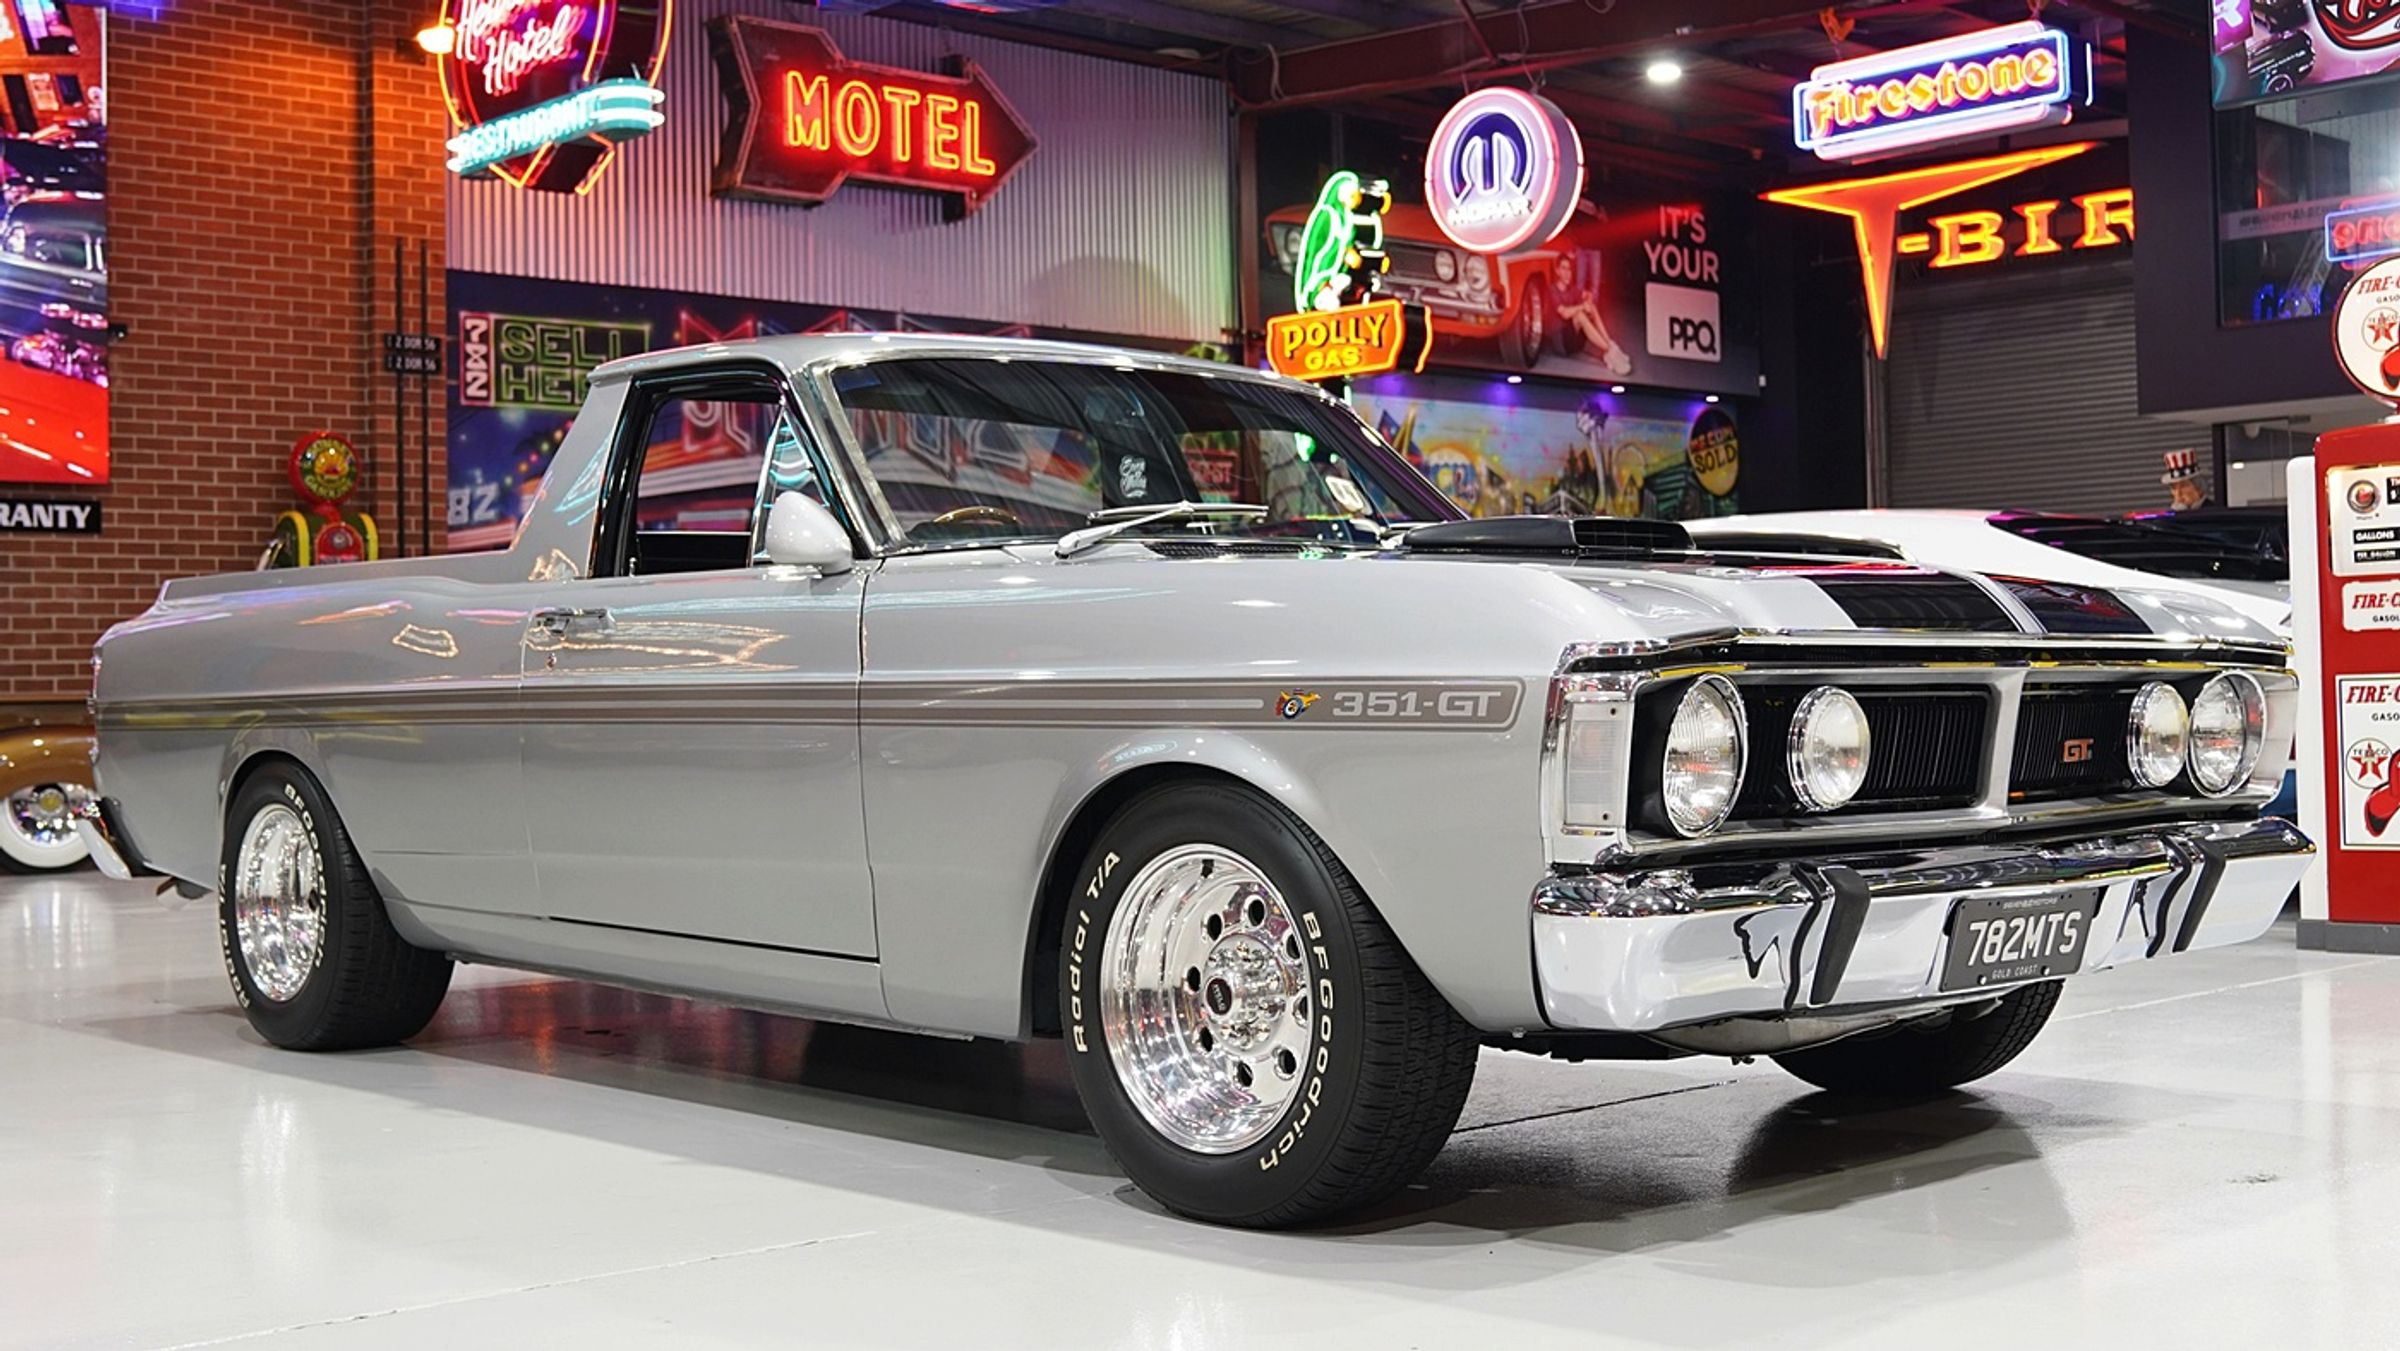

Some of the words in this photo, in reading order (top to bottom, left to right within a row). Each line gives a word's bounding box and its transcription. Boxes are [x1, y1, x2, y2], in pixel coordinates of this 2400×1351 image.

[483, 4, 566, 94] Hotel
[1807, 48, 2058, 138] Firestone
[458, 90, 597, 167] RESTAURANT
[785, 69, 996, 177] MOTEL
[1660, 205, 1707, 244] IT'S
[1643, 240, 1719, 283] YOUR
[1281, 313, 1388, 358] POLLY
[1669, 315, 1717, 354] PPQ
[1304, 346, 1360, 370] GAS
[1694, 444, 1736, 474] SOLD
[1332, 691, 1501, 717] 351-GT
[2063, 738, 2094, 762] GT
[1086, 851, 1121, 901] T/A
[1968, 911, 2082, 967] 782MTS
[1069, 910, 1092, 1053] Radial
[1992, 967, 2011, 979] GOLD
[2014, 964, 2038, 976] COAST
